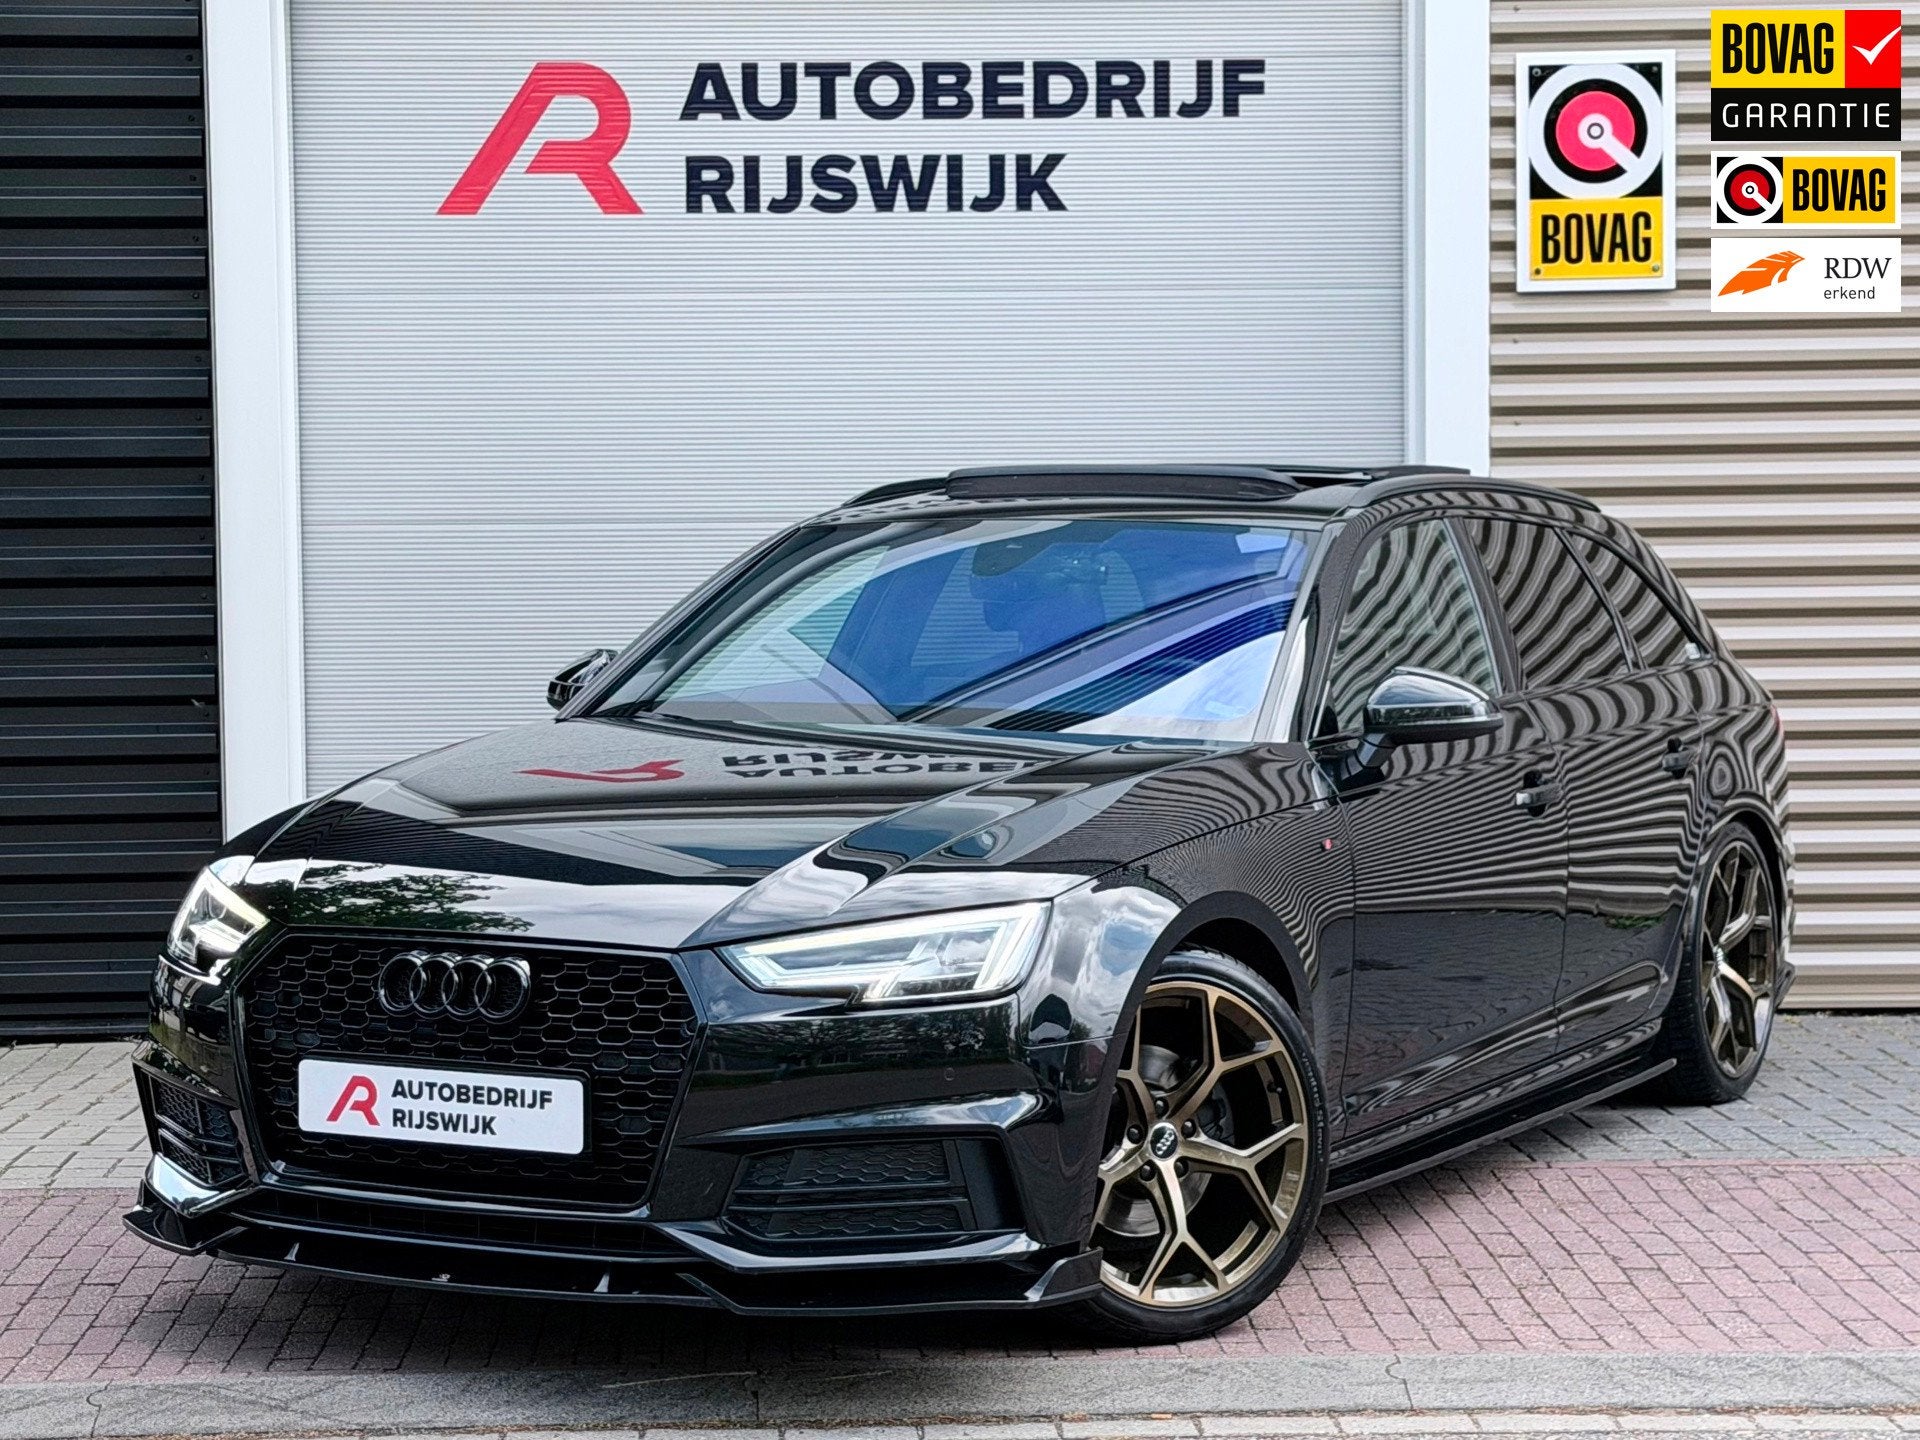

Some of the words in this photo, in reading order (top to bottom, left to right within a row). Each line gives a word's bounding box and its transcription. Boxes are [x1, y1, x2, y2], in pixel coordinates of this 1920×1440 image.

[679, 59, 1266, 120] AUTOBEDRIJF
[685, 153, 1067, 214] RIJSWIJK
[1540, 210, 1653, 265] BOVAG
[391, 1079, 553, 1110] AUTOBEDRIJF
[392, 1108, 497, 1136] RIJSWIJK
